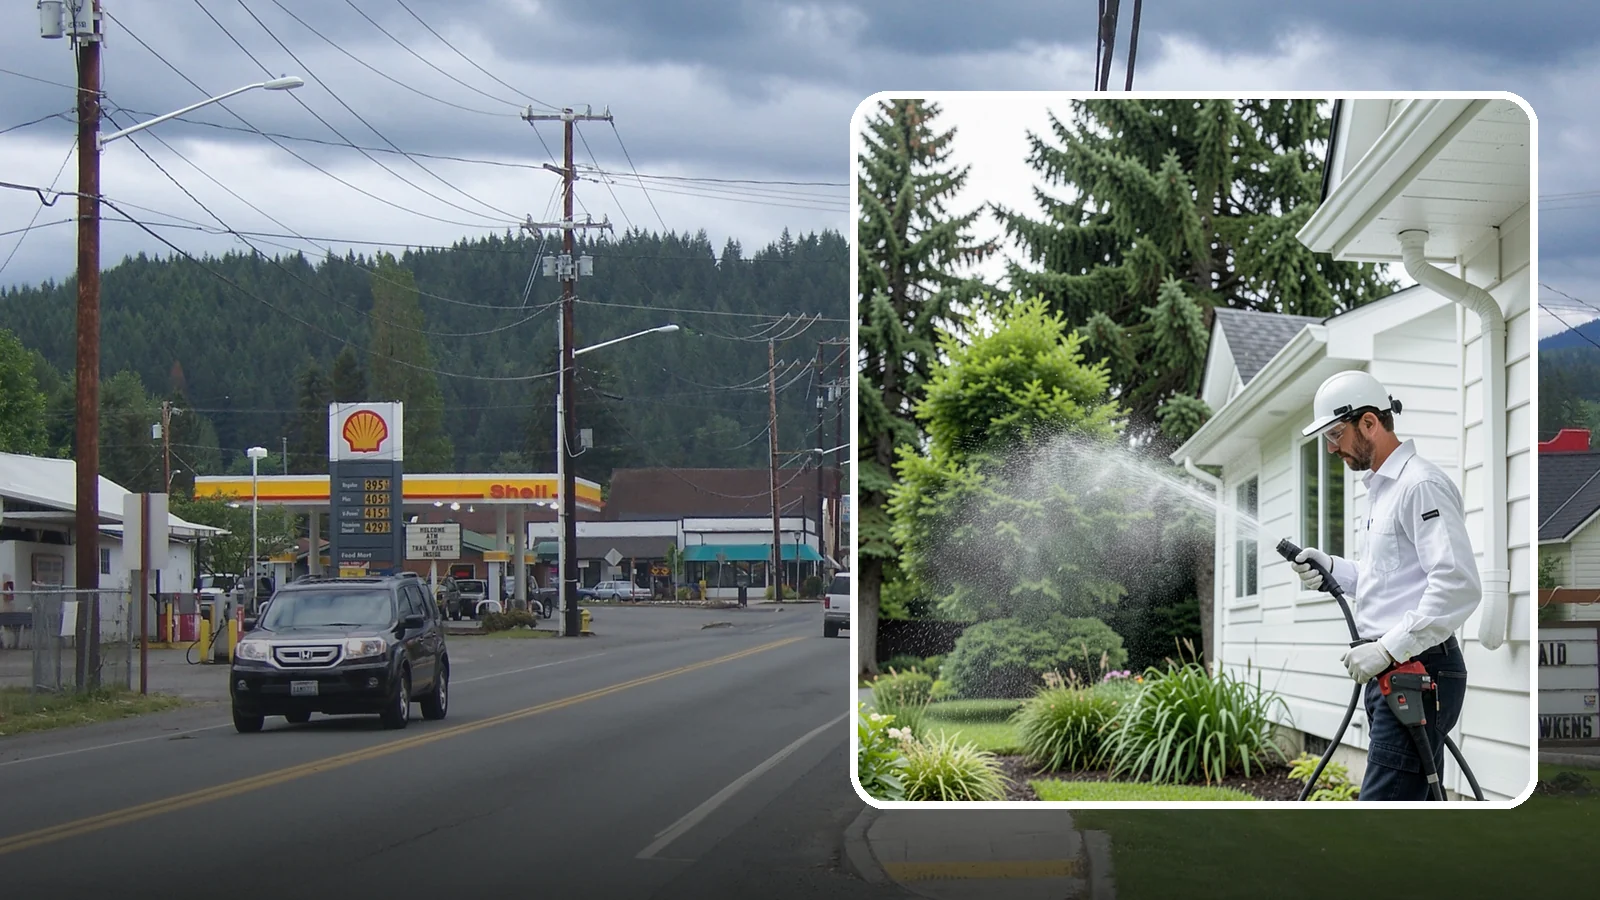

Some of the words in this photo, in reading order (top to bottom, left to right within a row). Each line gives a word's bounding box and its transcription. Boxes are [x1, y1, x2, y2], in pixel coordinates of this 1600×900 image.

[366, 480, 383, 490] 395
[490, 484, 548, 499] Shell
[365, 494, 384, 504] 405
[365, 508, 383, 518] 415
[365, 522, 383, 532] 429
